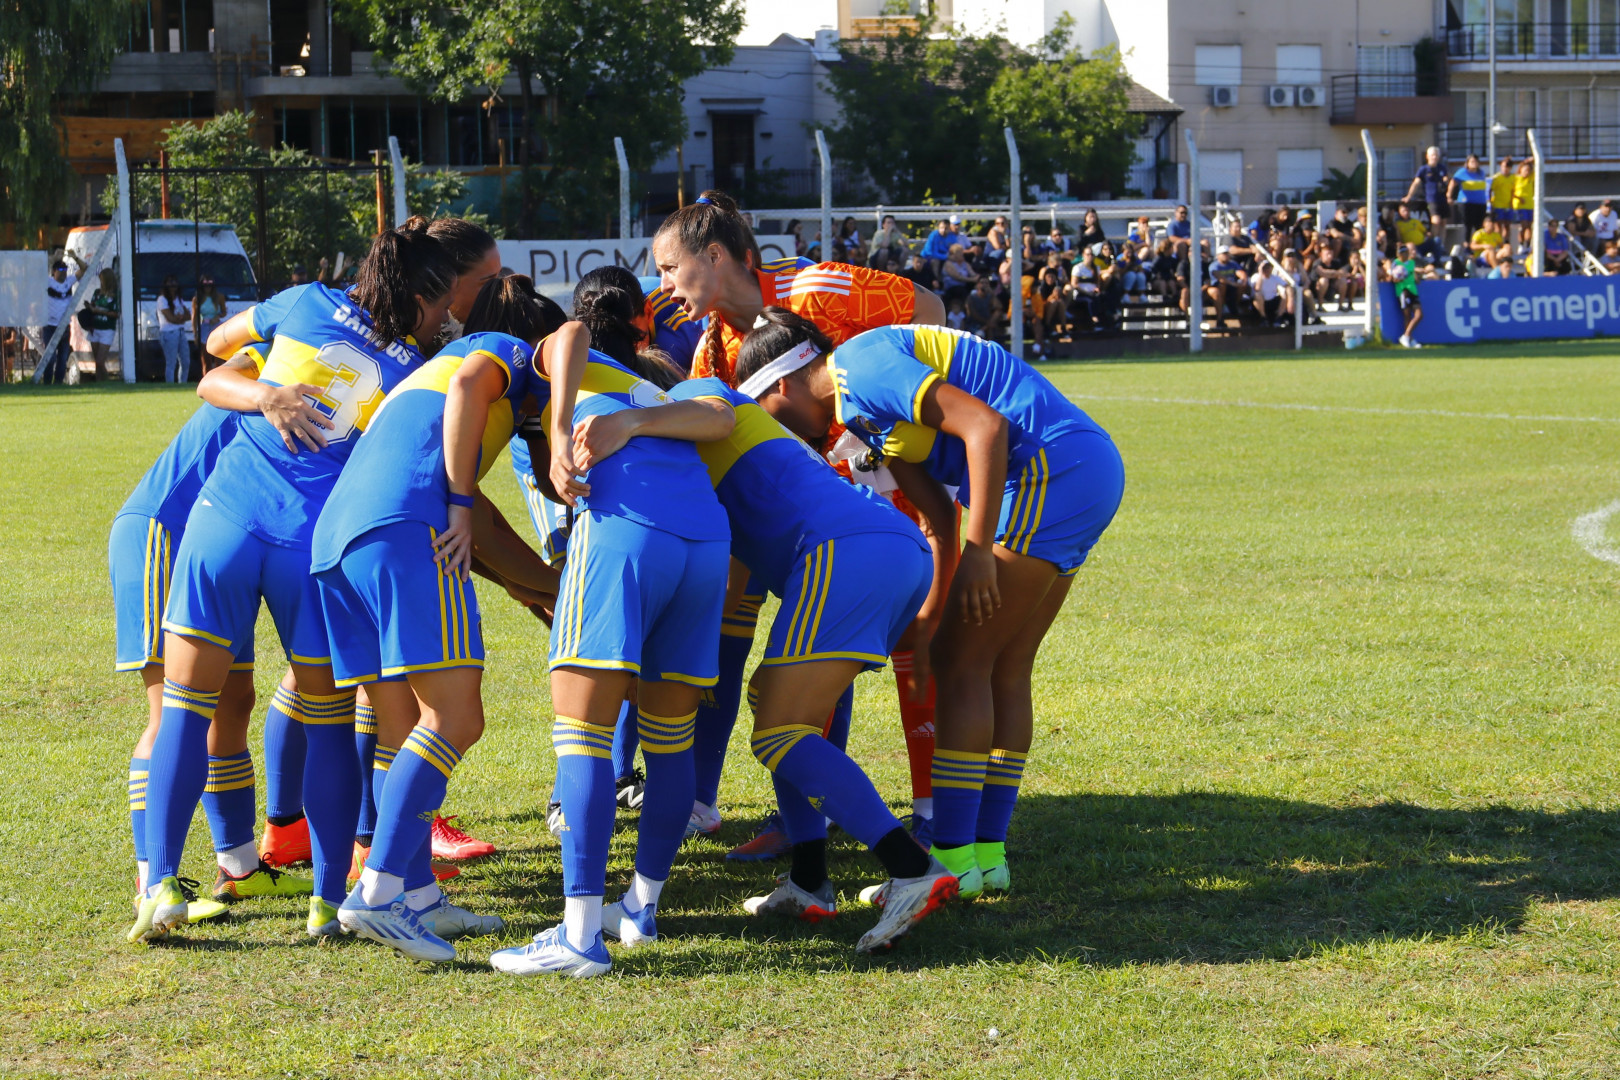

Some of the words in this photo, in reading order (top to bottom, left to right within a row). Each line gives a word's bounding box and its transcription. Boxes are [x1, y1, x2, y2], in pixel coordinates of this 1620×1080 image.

[333, 304, 415, 366] BAROS
[1491, 284, 1620, 330] cemepl
[303, 340, 383, 445] 3
